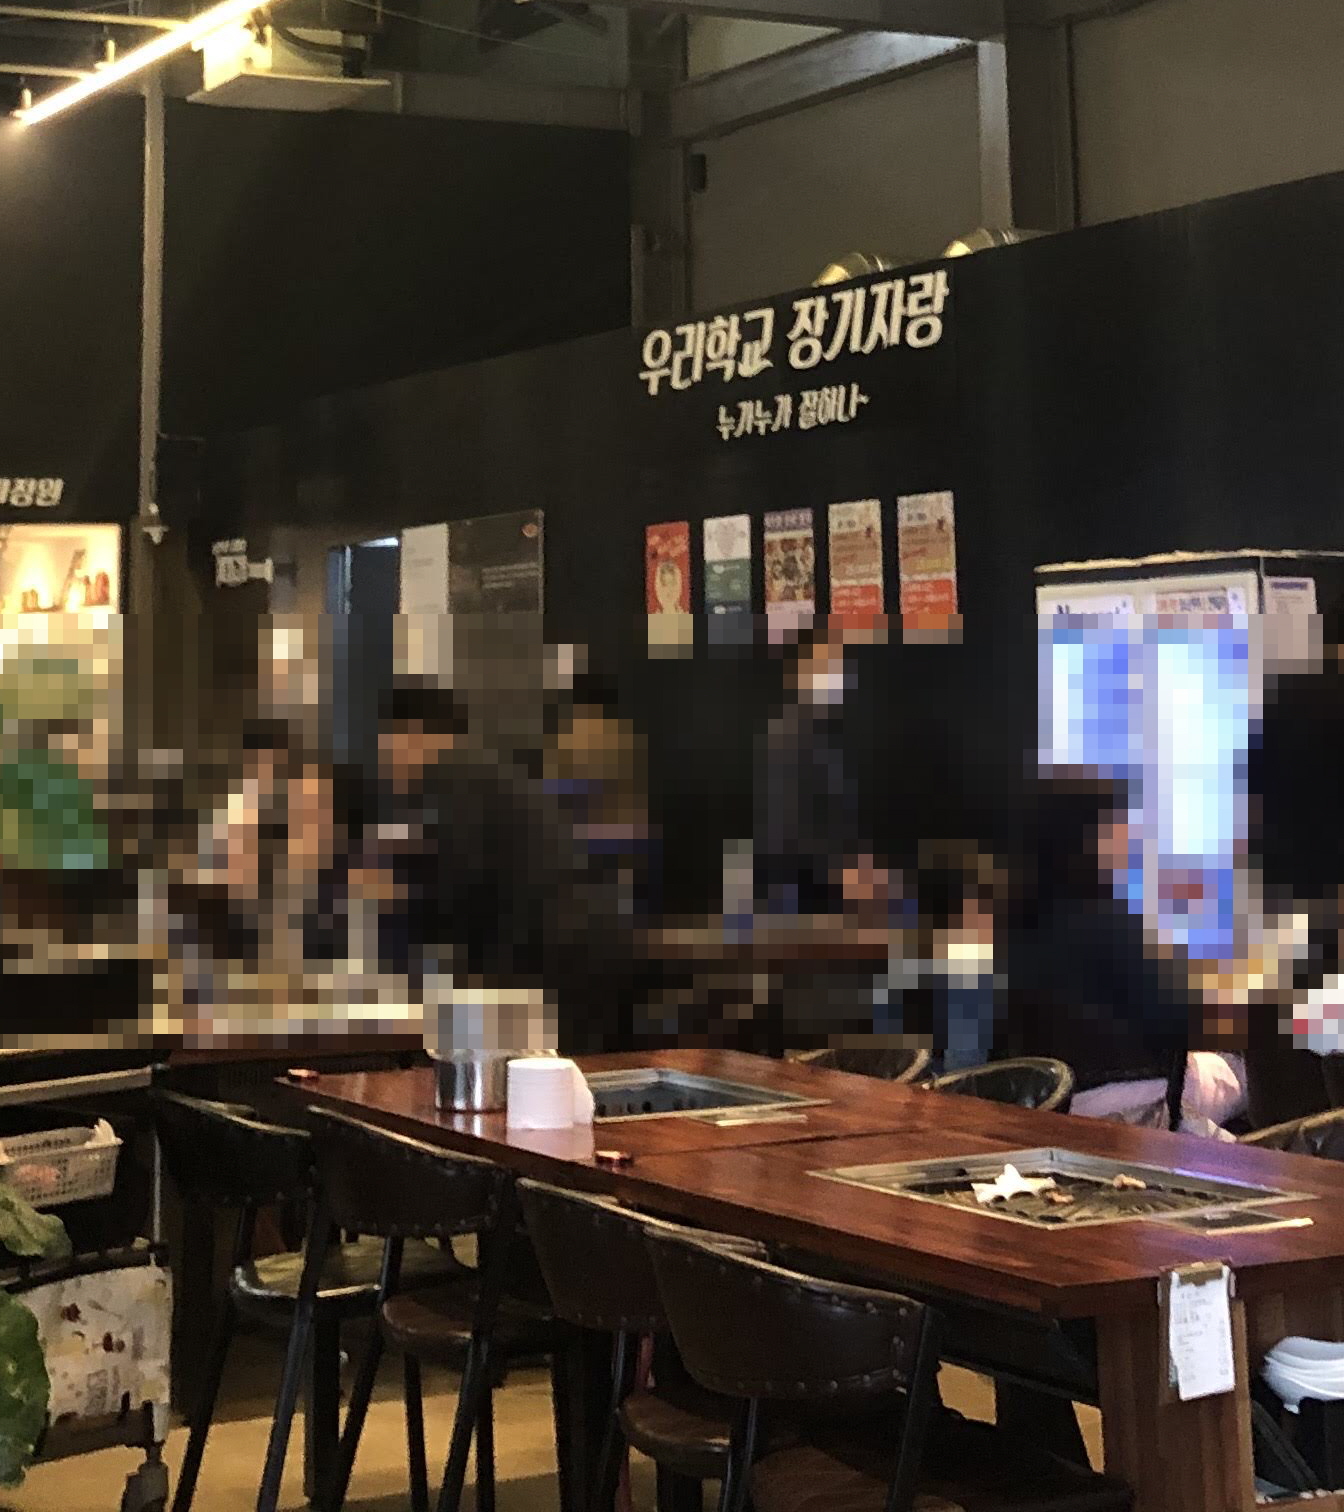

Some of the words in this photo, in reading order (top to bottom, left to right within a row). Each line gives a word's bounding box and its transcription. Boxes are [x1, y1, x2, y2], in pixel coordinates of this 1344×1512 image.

[639, 307, 774, 396] 우리학교
[787, 270, 949, 369] 장기자랑
[716, 393, 793, 441] 누가누가
[798, 382, 870, 430] 잘하나
